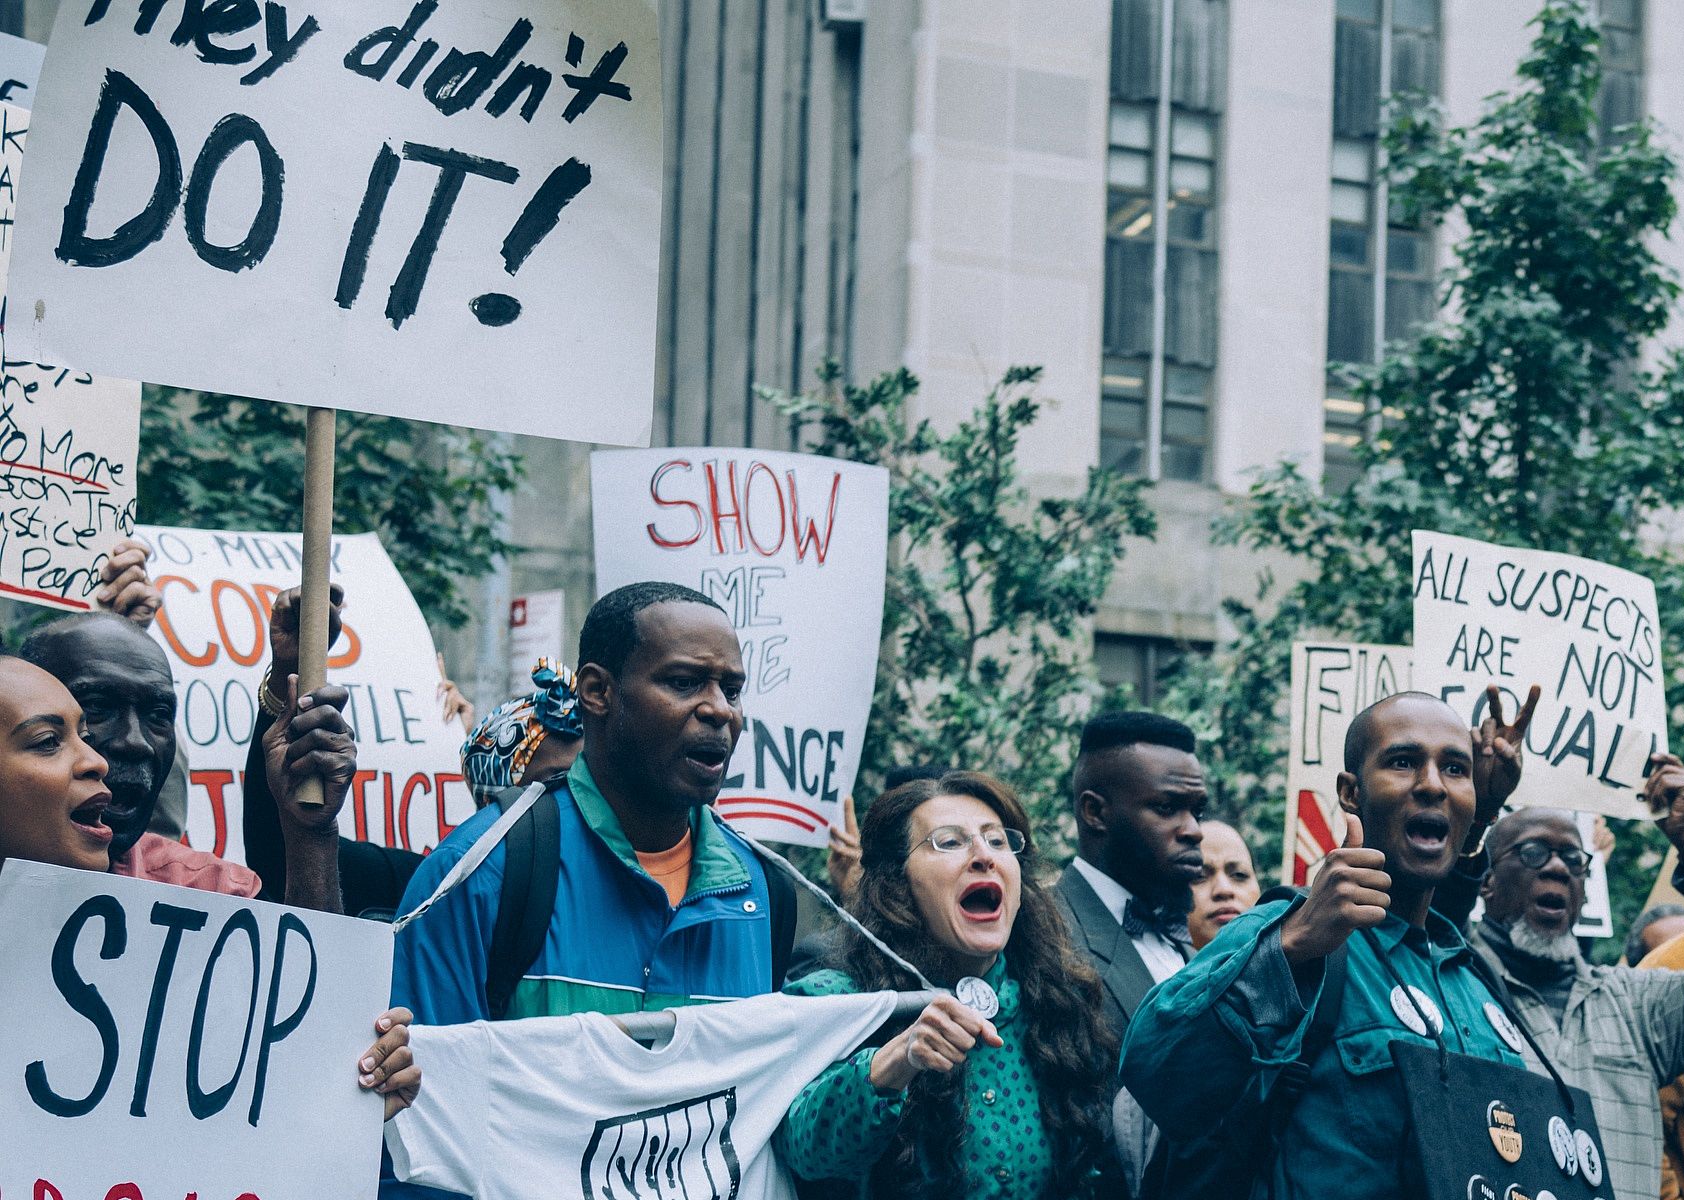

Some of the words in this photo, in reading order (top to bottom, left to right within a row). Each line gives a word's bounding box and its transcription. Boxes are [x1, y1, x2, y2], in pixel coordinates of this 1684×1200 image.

[84, 0, 321, 86] ey
[343, 0, 633, 124] didn't
[55, 68, 286, 273] DO
[333, 139, 592, 331] IT!
[646, 458, 842, 567] SHOW
[702, 566, 787, 630] ME
[1413, 546, 1470, 607] ALL
[1487, 562, 1656, 669] SUSPECTS
[174, 679, 255, 746] OO
[1446, 623, 1520, 677] ARE
[1556, 643, 1654, 719] NOT
[24, 893, 318, 1127] STOP
